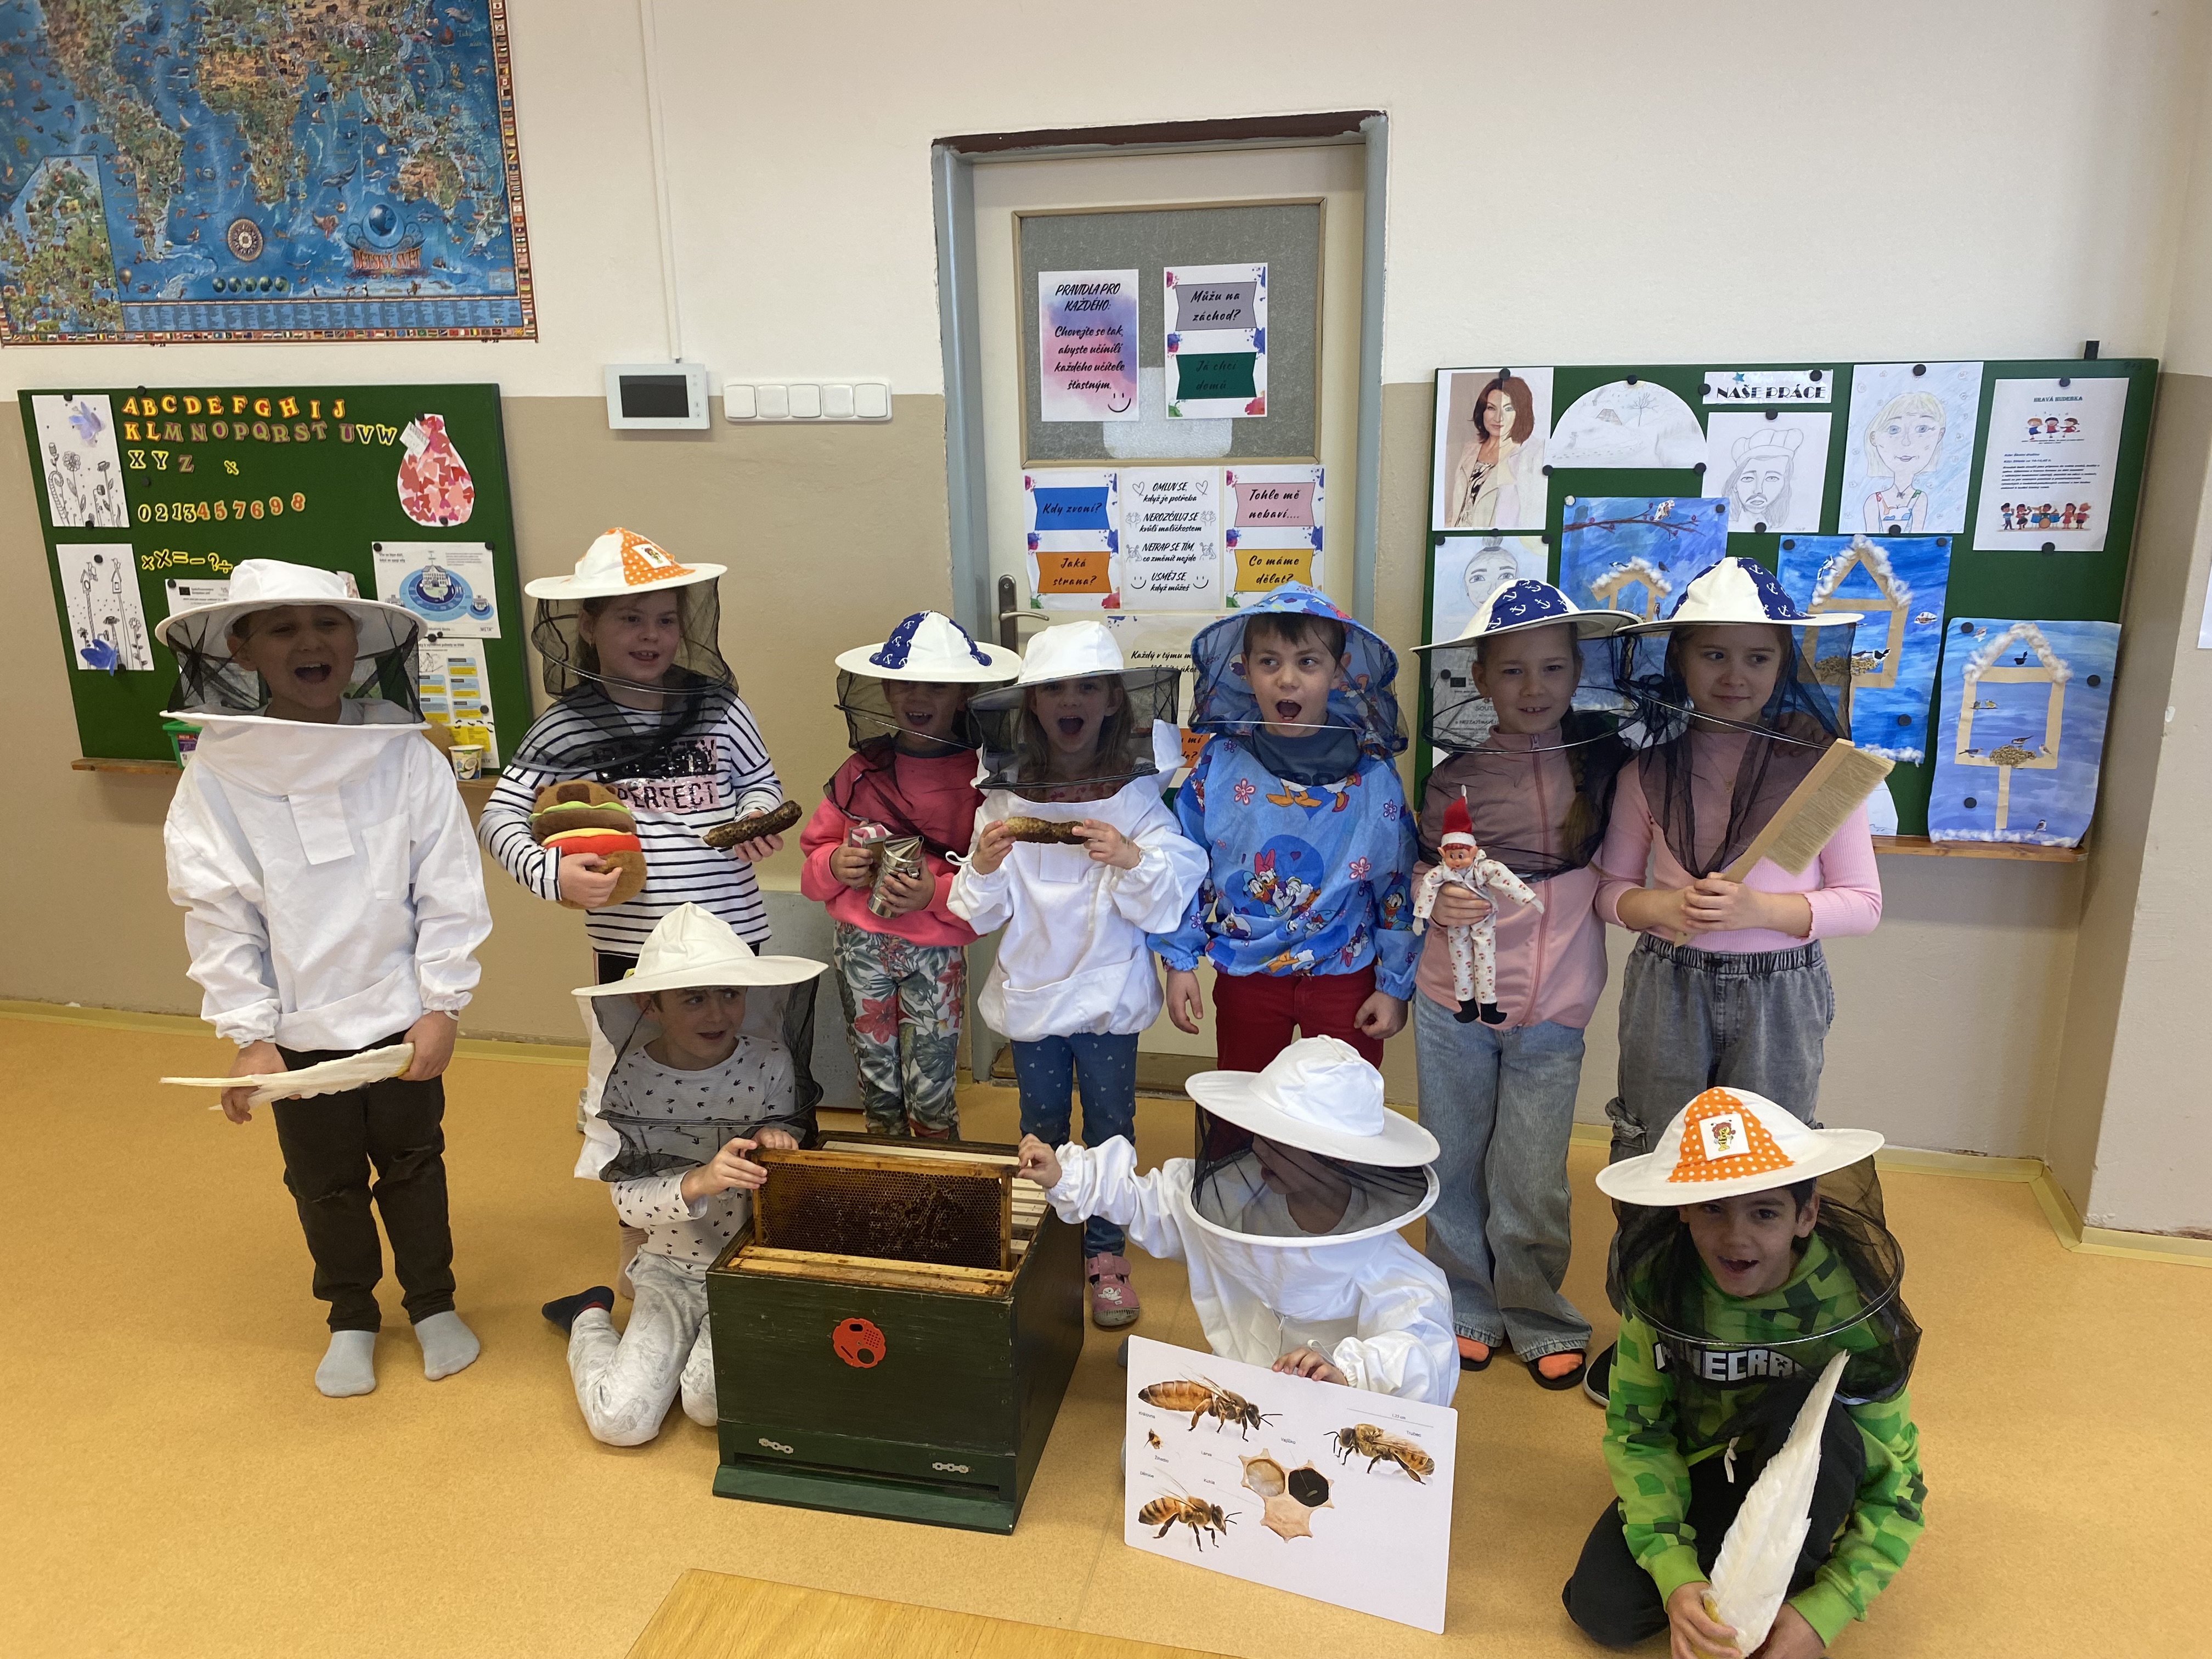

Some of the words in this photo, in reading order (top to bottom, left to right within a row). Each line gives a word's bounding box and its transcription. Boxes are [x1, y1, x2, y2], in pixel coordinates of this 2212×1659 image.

[1055, 284, 1100, 296] PRAVIDLA
[1100, 283, 1121, 295] PRO
[1190, 290, 1222, 303] Můžu
[1064, 297, 1111, 312] KAŽDÉHO:
[1192, 309, 1242, 321] záchod?
[1054, 326, 1094, 340] Chovejte
[1107, 325, 1124, 337] tak,
[1058, 345, 1088, 358] abyste
[1054, 362, 1092, 373] každého
[1094, 360, 1125, 371] učitele
[1196, 360, 1209, 373] Já
[1067, 379, 1111, 393] šťastným.
[1717, 384, 1762, 398] NAŠE
[1765, 384, 1826, 398] PRÁCE
[1152, 482, 1178, 492] OMLUV
[1177, 482, 1188, 492] SE,
[1143, 494, 1160, 504] když
[1159, 494, 1169, 504] je
[1168, 494, 1197, 504] potřeba
[1249, 489, 1279, 501] Tohle
[1283, 489, 1301, 500] mě
[1042, 503, 1063, 516] Kdy
[1066, 503, 1103, 514] zvoní?
[1143, 510, 1190, 522] NEROZČILUJ
[1188, 512, 1200, 521] SE
[1139, 524, 1159, 533] kvůli
[1142, 543, 1171, 552] NETRAP
[1170, 543, 1181, 551] SE
[1181, 540, 1195, 552] TÍM,
[1060, 557, 1087, 569] Jaká
[1176, 554, 1197, 564] nejde
[1249, 555, 1262, 566] Co
[1266, 556, 1300, 566] máme
[1053, 575, 1097, 585] strana?
[1151, 570, 1177, 581] USMĚJ
[1176, 572, 1187, 582] SE,
[1256, 573, 1294, 585] dělat?
[1150, 584, 1168, 593] když
[1131, 651, 1156, 661] Každý
[1162, 652, 1183, 661] týmu
